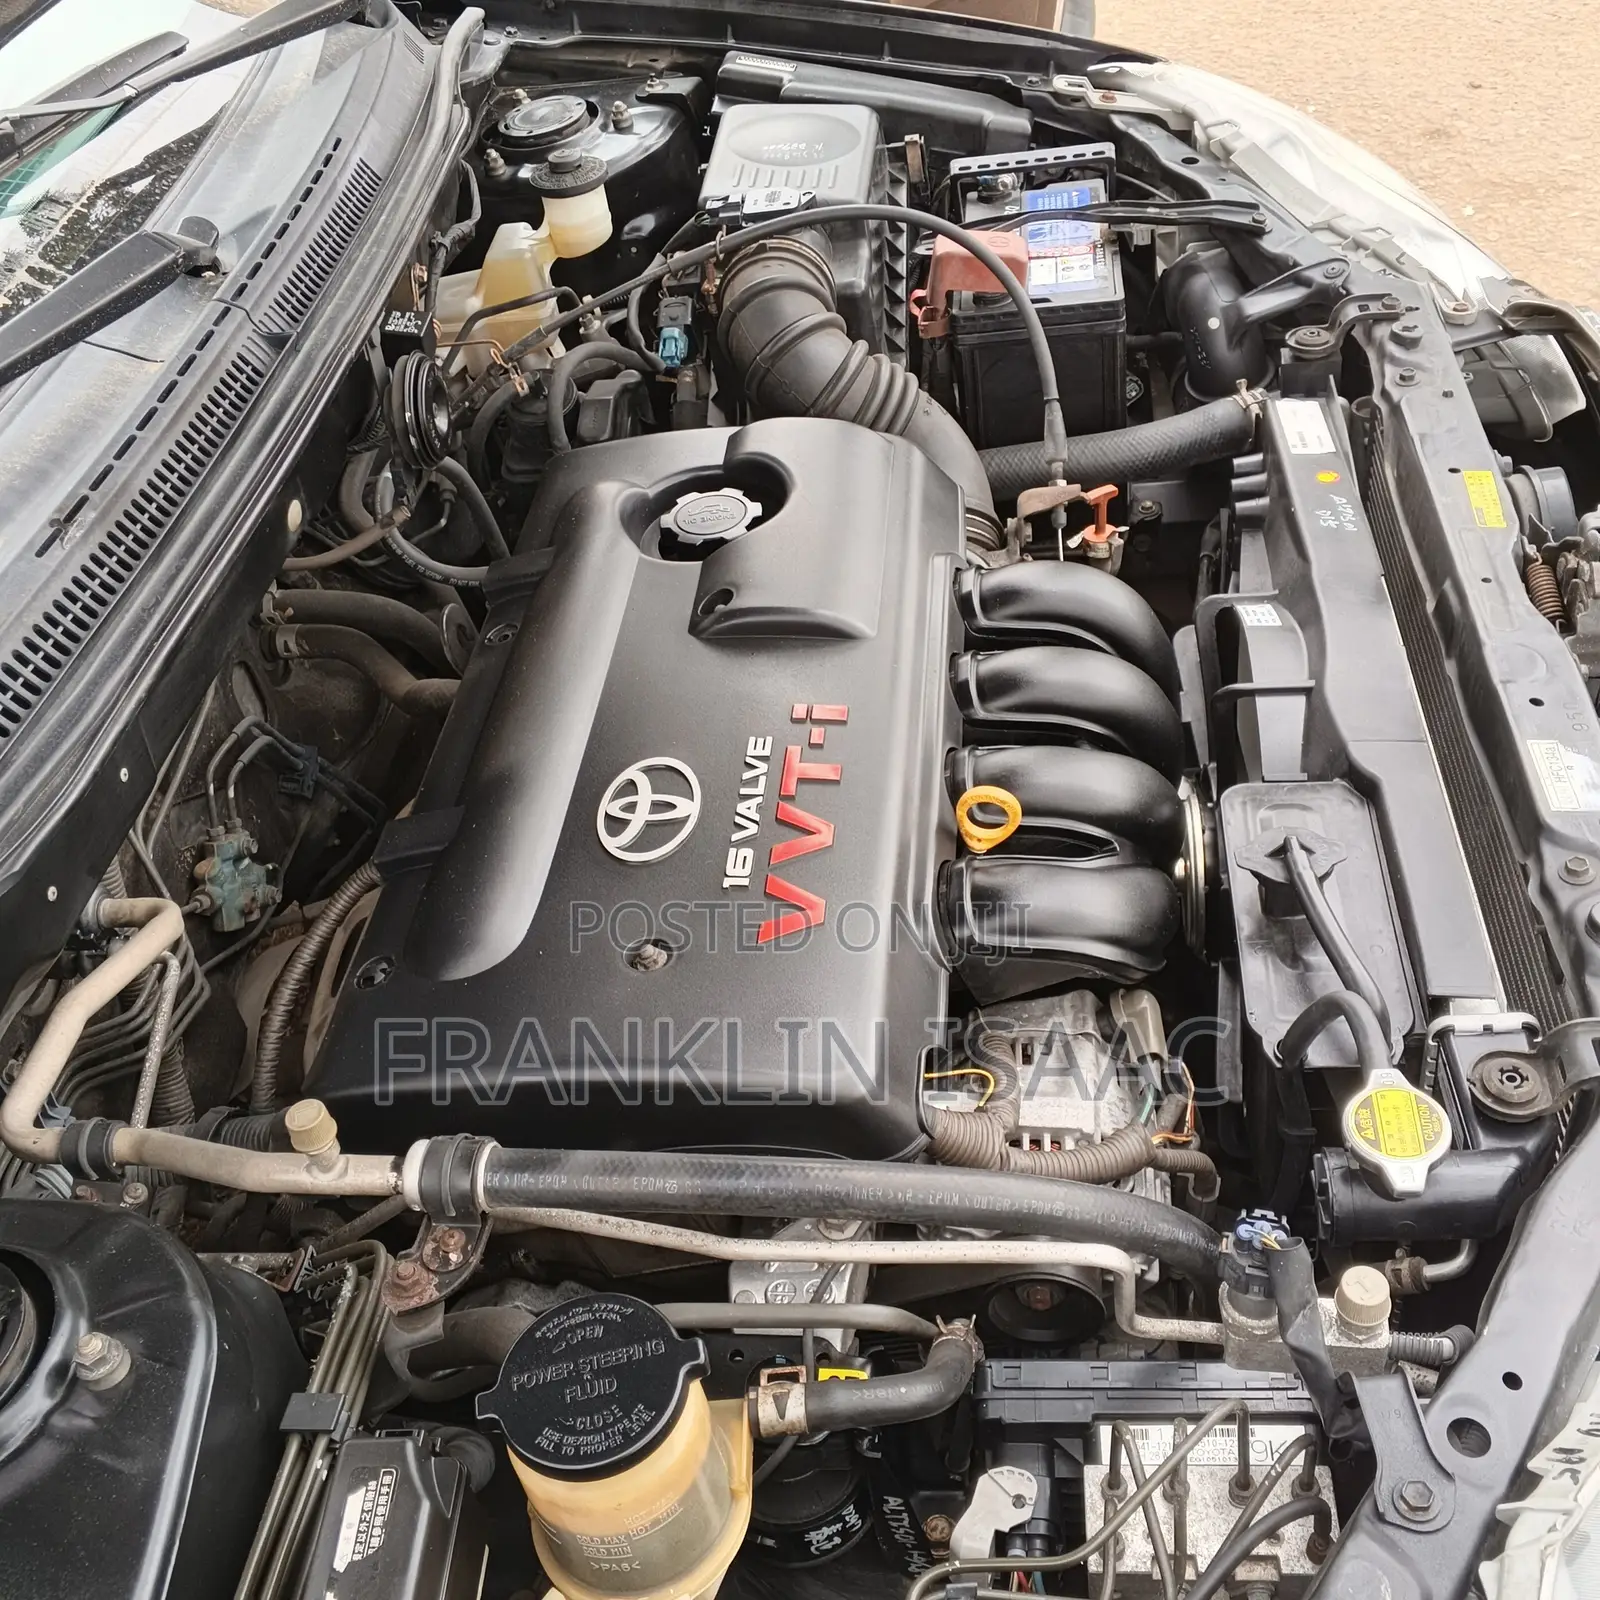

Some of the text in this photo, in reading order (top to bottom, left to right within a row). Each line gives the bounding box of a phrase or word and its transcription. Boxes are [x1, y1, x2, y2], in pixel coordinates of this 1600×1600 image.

[722, 735, 773, 890] 16 VALVE
[1418, 1104, 1436, 1141] CAUTION
[565, 1325, 605, 1346] OPEN
[510, 1339, 666, 1392] POWER STEERING
[563, 1377, 618, 1404] FLUID
[576, 1404, 623, 1431] CLOSE
[534, 1410, 657, 1457] FILL TO PROPER LEVEL
[542, 1427, 563, 1444] USE
[1190, 1447, 1236, 1457] TOYOTA
[1251, 1439, 1288, 1463] 9K
[576, 1534, 628, 1545] COLD MAX
[628, 1522, 652, 1538] HOT
[582, 1545, 632, 1557] COLD MIN
